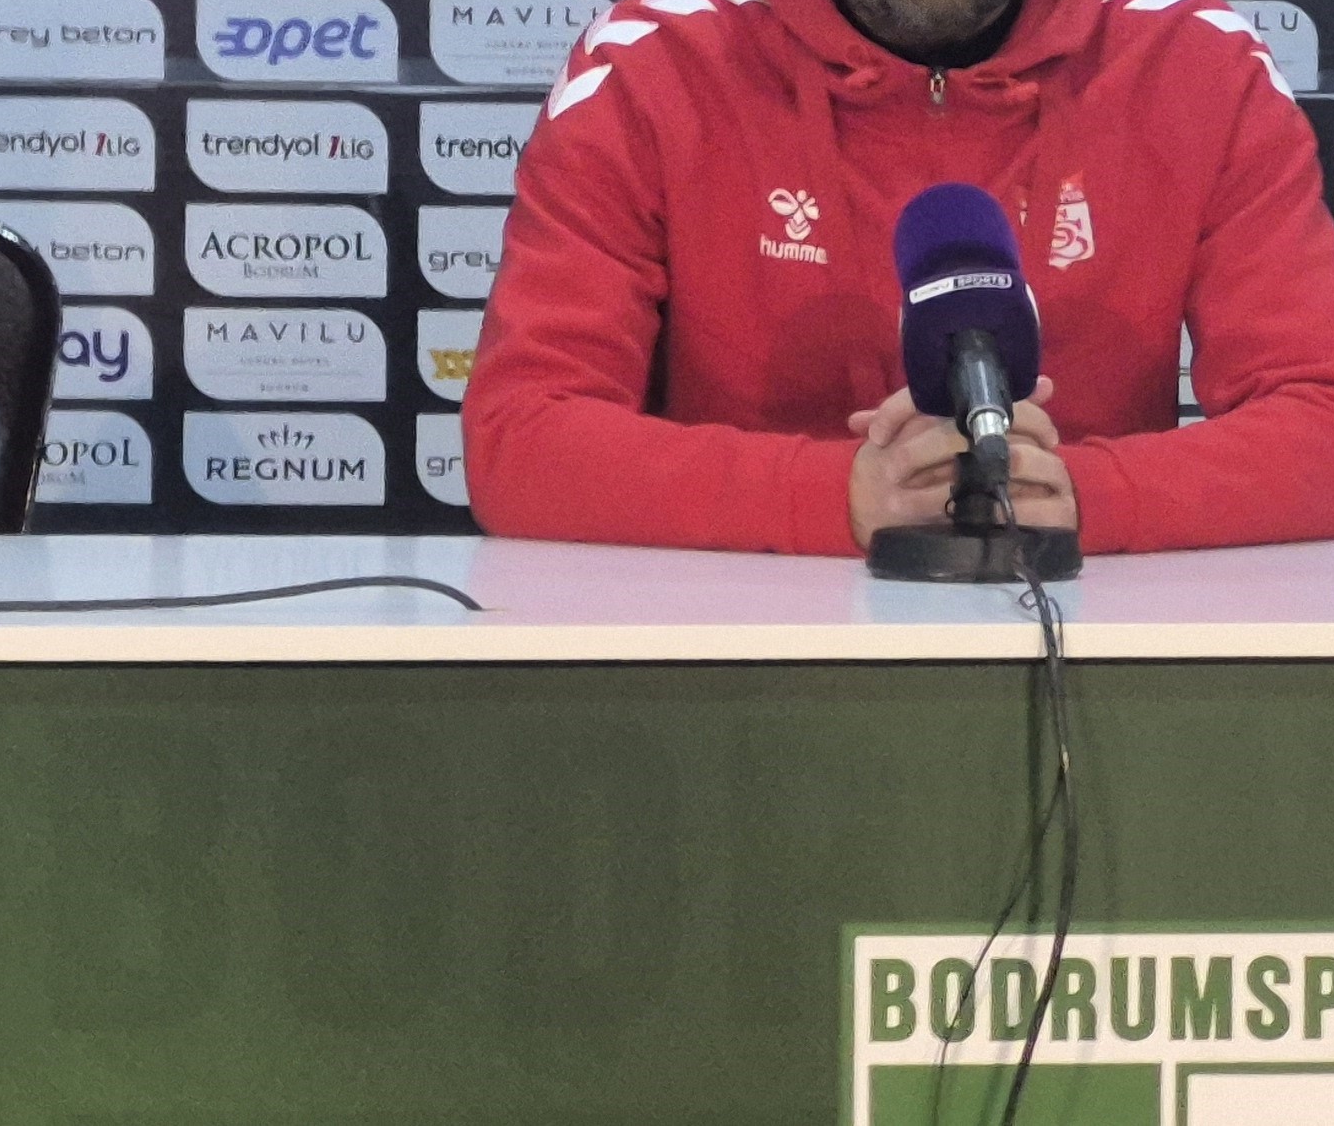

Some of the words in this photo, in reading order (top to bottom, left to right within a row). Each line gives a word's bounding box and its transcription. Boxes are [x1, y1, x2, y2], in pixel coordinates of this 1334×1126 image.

[213, 13, 379, 65] opet
[202, 133, 319, 160] trendyol
[50, 240, 145, 260] beton
[201, 232, 371, 260] ACROPOL
[43, 437, 140, 467] OPOL
[206, 456, 365, 481] REGNUM
